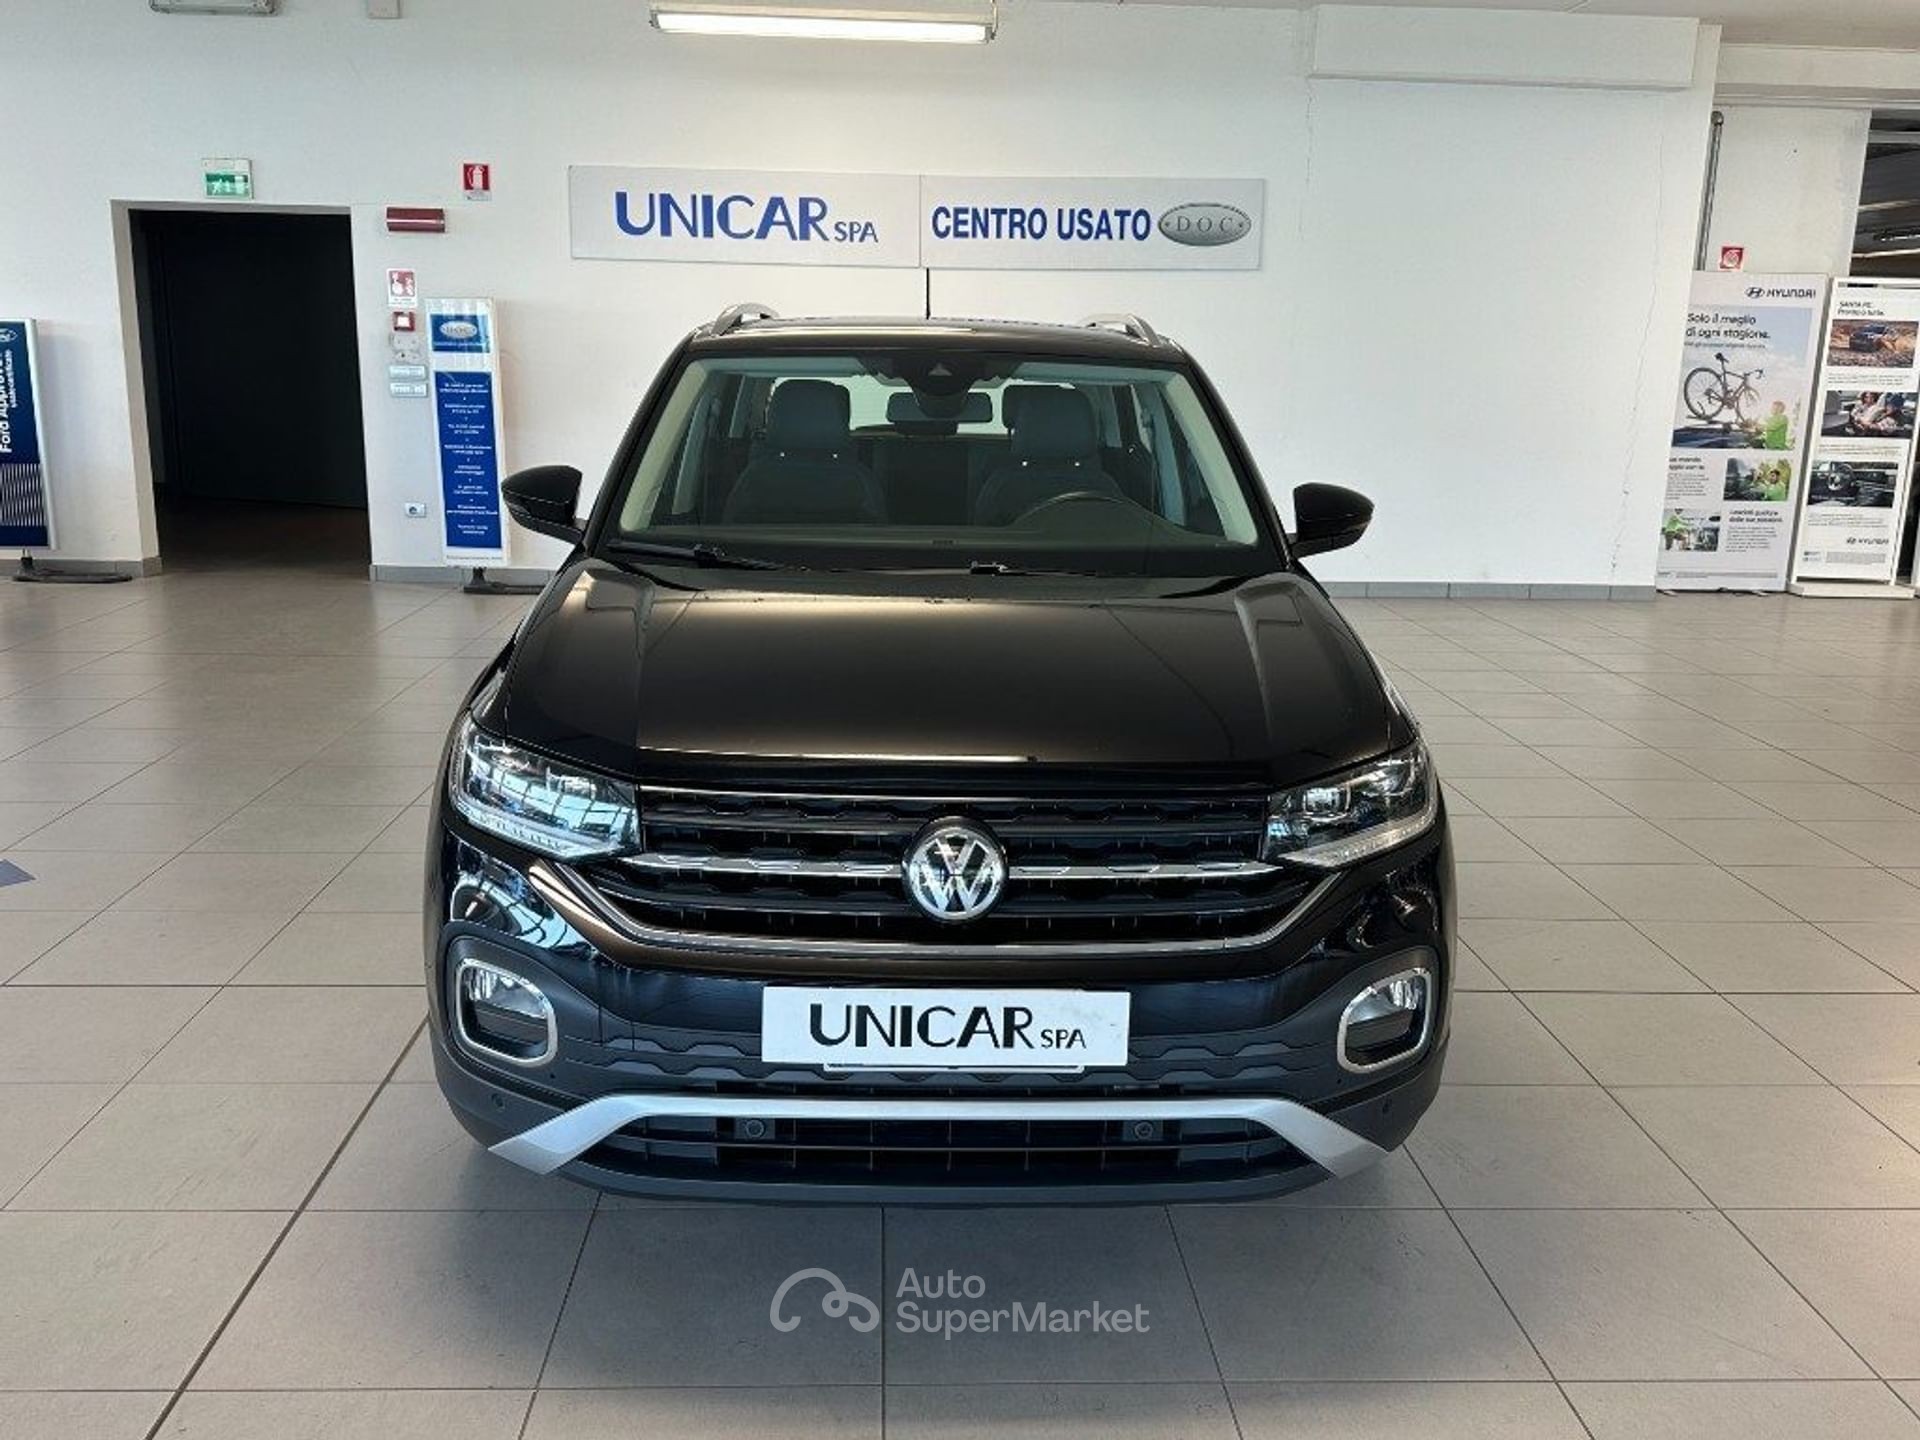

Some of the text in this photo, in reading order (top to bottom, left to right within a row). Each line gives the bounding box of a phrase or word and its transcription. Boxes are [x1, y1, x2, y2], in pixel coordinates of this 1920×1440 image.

[615, 192, 878, 243] UNICAR SPA
[932, 206, 1150, 241] CENTRO USATO
[1767, 289, 1816, 298] HYUNDAI
[1688, 313, 1709, 324] Solo
[1720, 314, 1756, 327] meglio
[1686, 326, 1696, 337] di
[1698, 328, 1720, 339] ogni
[809, 1003, 1086, 1049] UNICAR SPA
